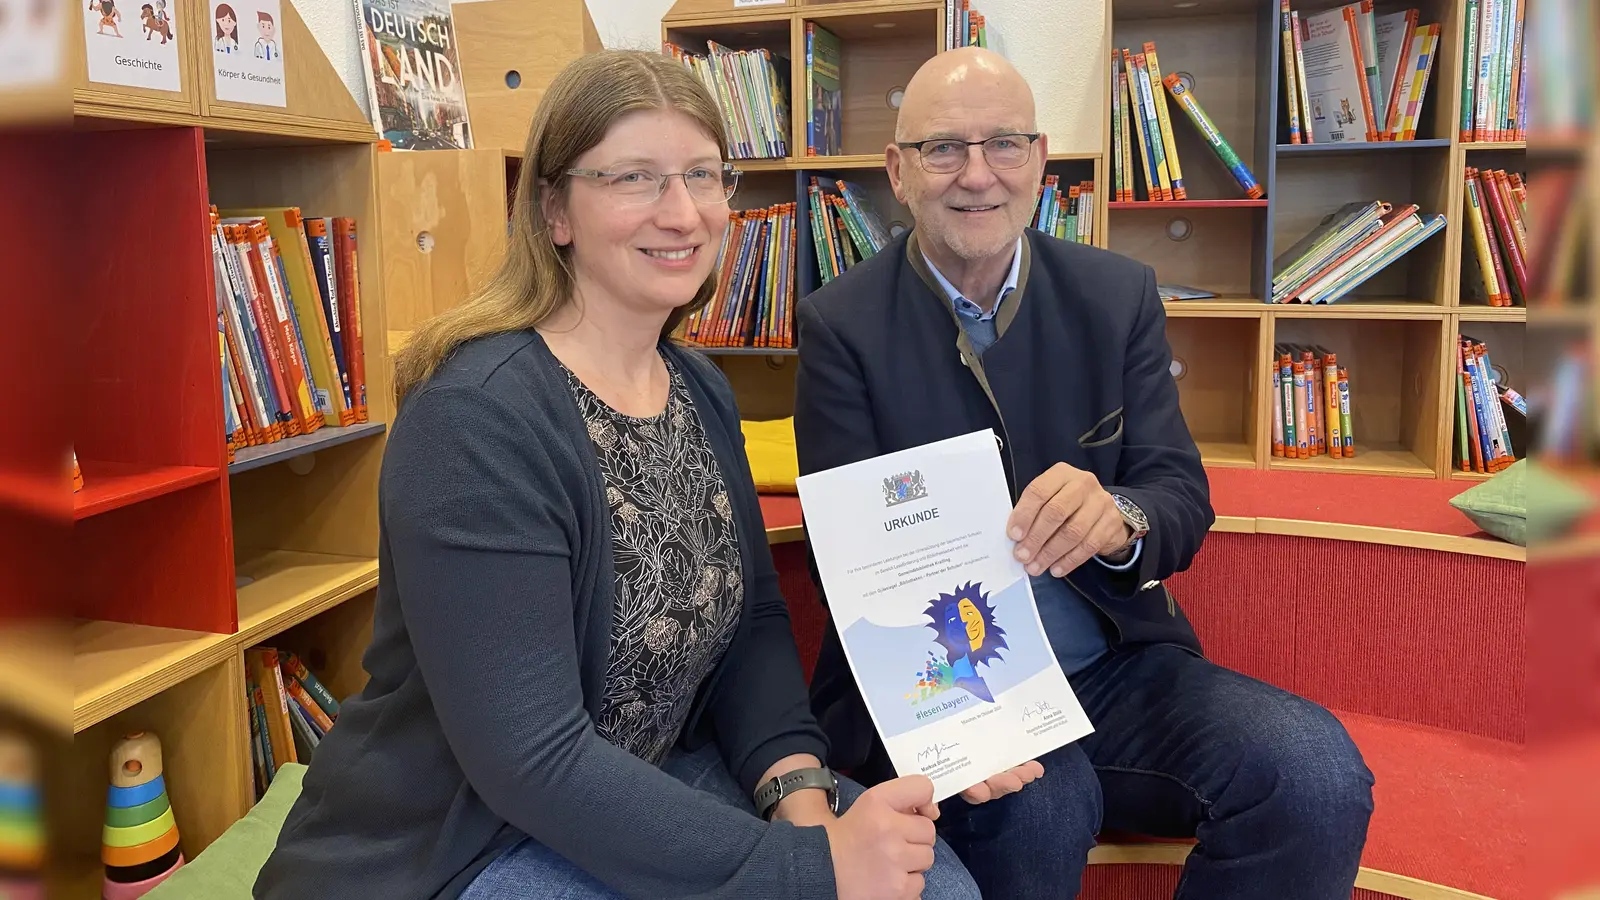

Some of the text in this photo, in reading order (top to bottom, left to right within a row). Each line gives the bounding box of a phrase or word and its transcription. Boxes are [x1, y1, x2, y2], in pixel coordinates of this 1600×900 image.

[370, 7, 450, 49] DEUTSCH
[114, 55, 163, 71] Geschichte
[376, 40, 455, 95] LAND
[1479, 54, 1491, 78] Tiere
[218, 68, 281, 85] Körper & Gesundheit
[227, 261, 236, 280] Sterben
[283, 324, 300, 367] Mein Körper
[884, 508, 940, 532] URKUNDE
[897, 562, 935, 577] Gemeindebibliothek
[925, 569, 940, 578] Partner
[313, 681, 334, 705] Beim Arzt
[915, 694, 969, 720] #lesen.bayern
[921, 757, 950, 772] Markus Blume
